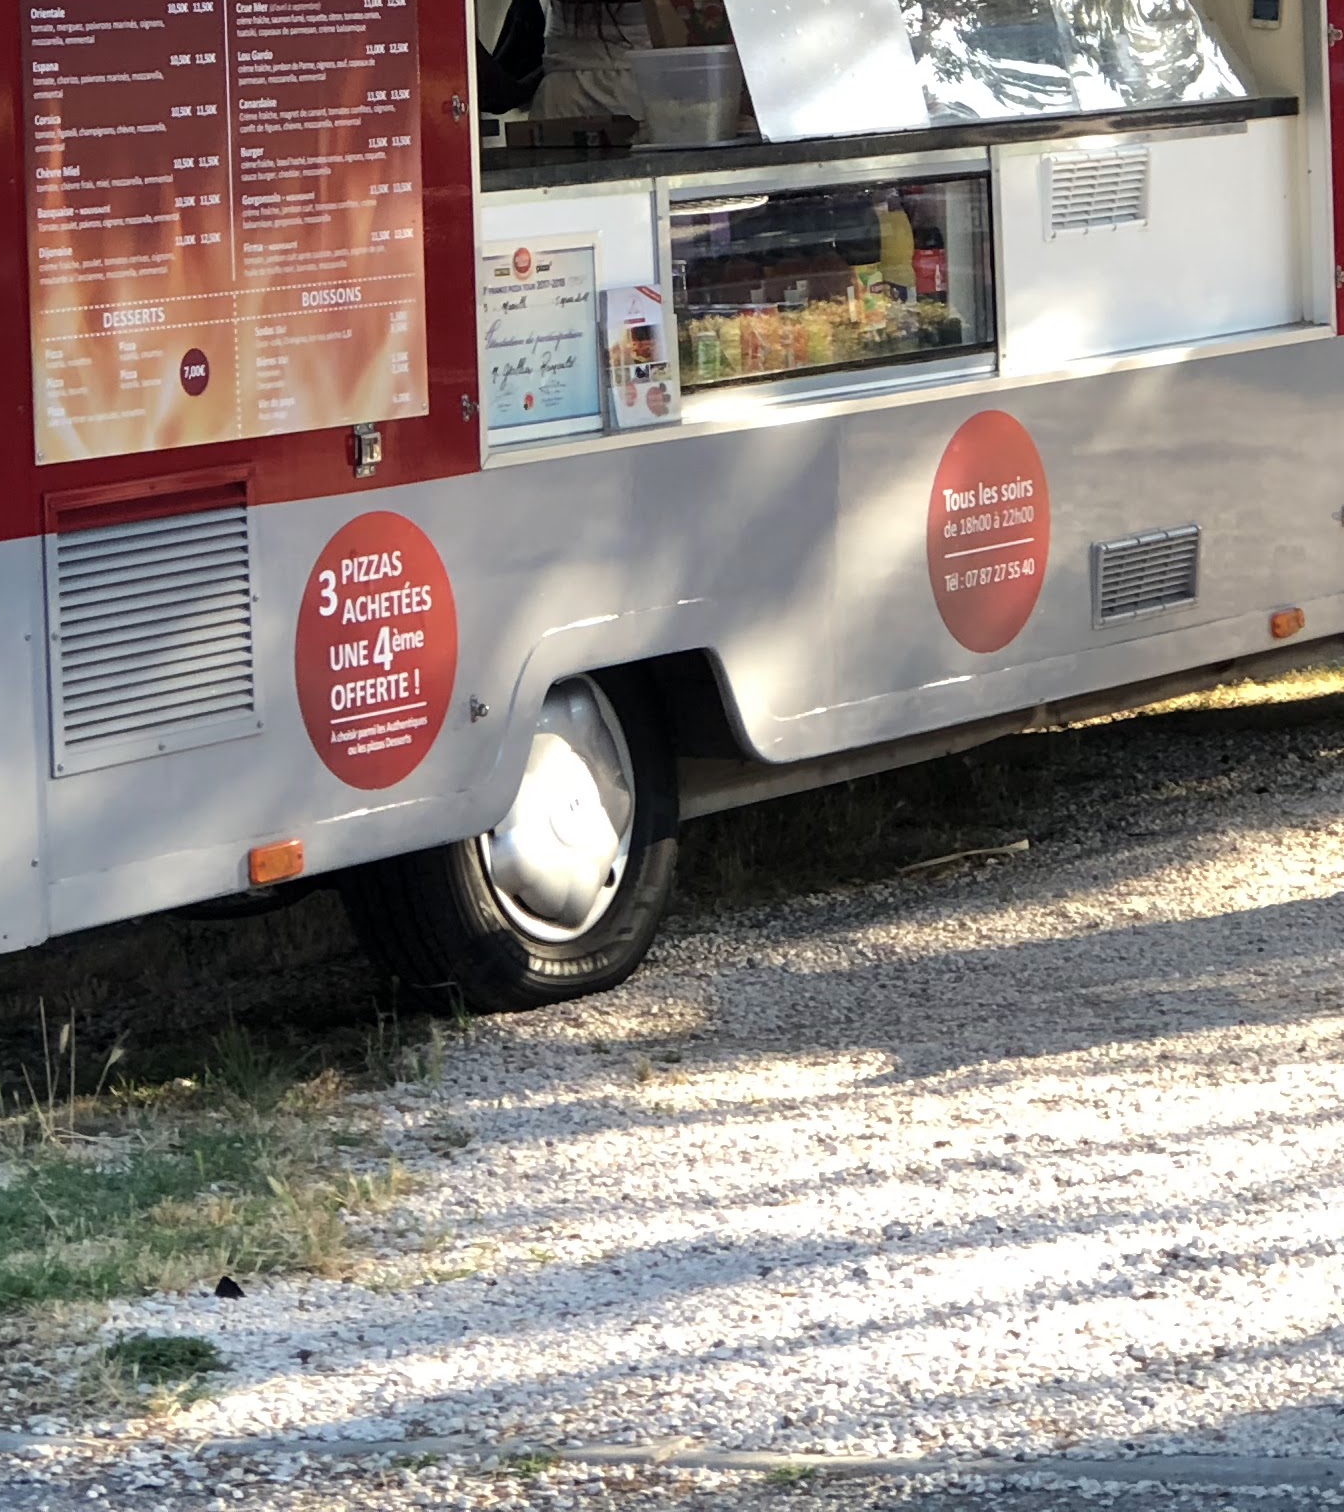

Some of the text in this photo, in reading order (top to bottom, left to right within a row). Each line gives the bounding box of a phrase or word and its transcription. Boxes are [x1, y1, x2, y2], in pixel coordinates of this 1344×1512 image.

[302, 286, 362, 307] BOISSONS
[103, 307, 166, 329] DESSERTS
[183, 364, 206, 379] 7,00€
[943, 476, 1033, 512] Tous les soirs
[944, 505, 1034, 539] de 18h00 à 22h00
[318, 550, 403, 617] 3 PIZZAS
[965, 569, 979, 588] 07
[980, 566, 993, 585] 87
[993, 563, 1007, 582] 27
[1007, 560, 1020, 579] 55
[1021, 558, 1035, 576] 40
[342, 580, 433, 625] ACHETÉES
[329, 625, 424, 671] UNE 4ème
[330, 668, 421, 711] OFFERTE !
[386, 716, 428, 732] Authentiques
